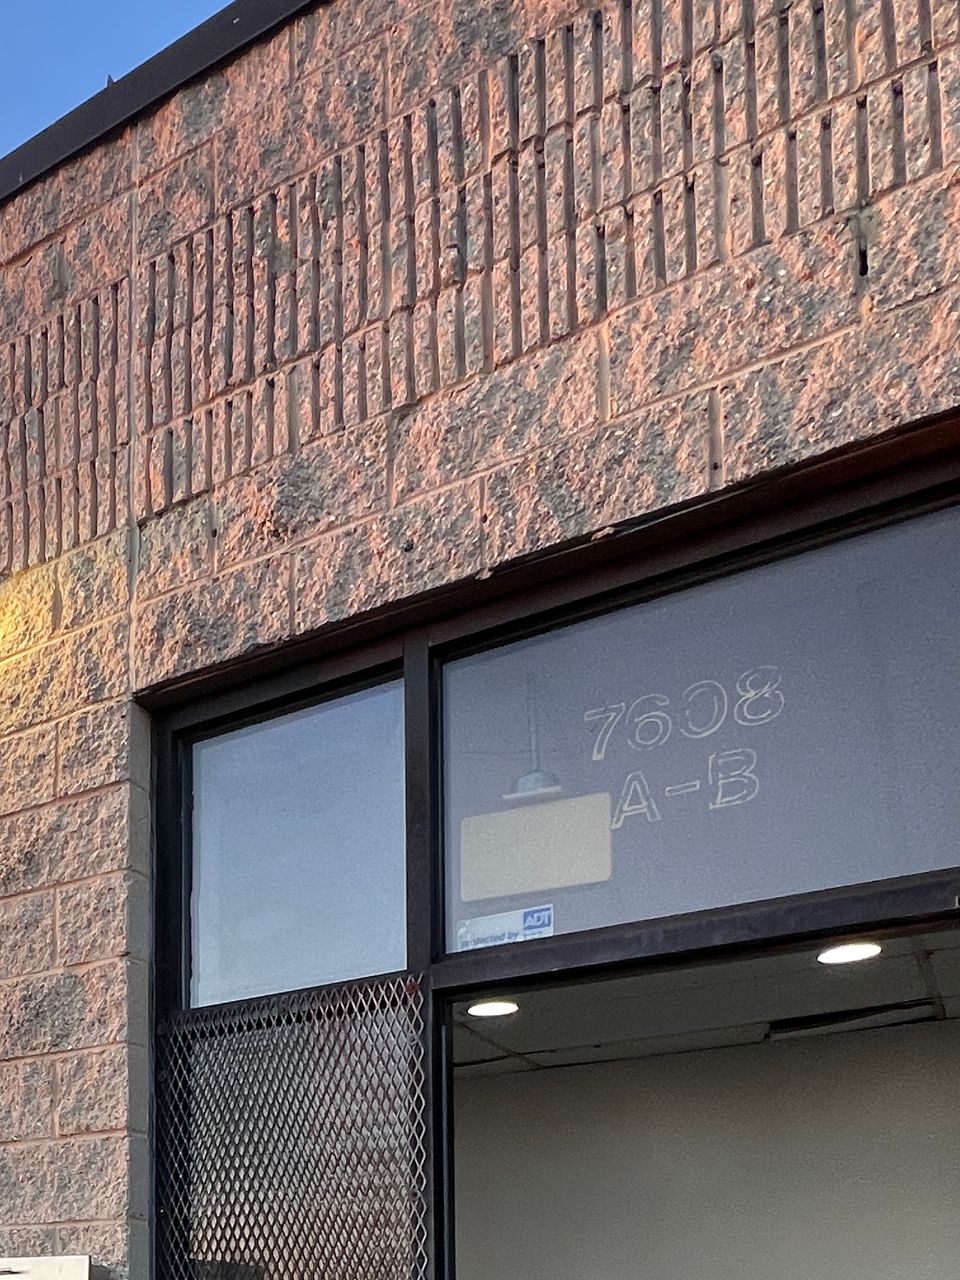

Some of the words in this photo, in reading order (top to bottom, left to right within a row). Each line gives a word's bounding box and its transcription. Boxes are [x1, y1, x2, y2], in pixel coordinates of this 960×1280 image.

[584, 666, 784, 760] 7608
[611, 748, 760, 830] A-B
[525, 911, 549, 926] ADT
